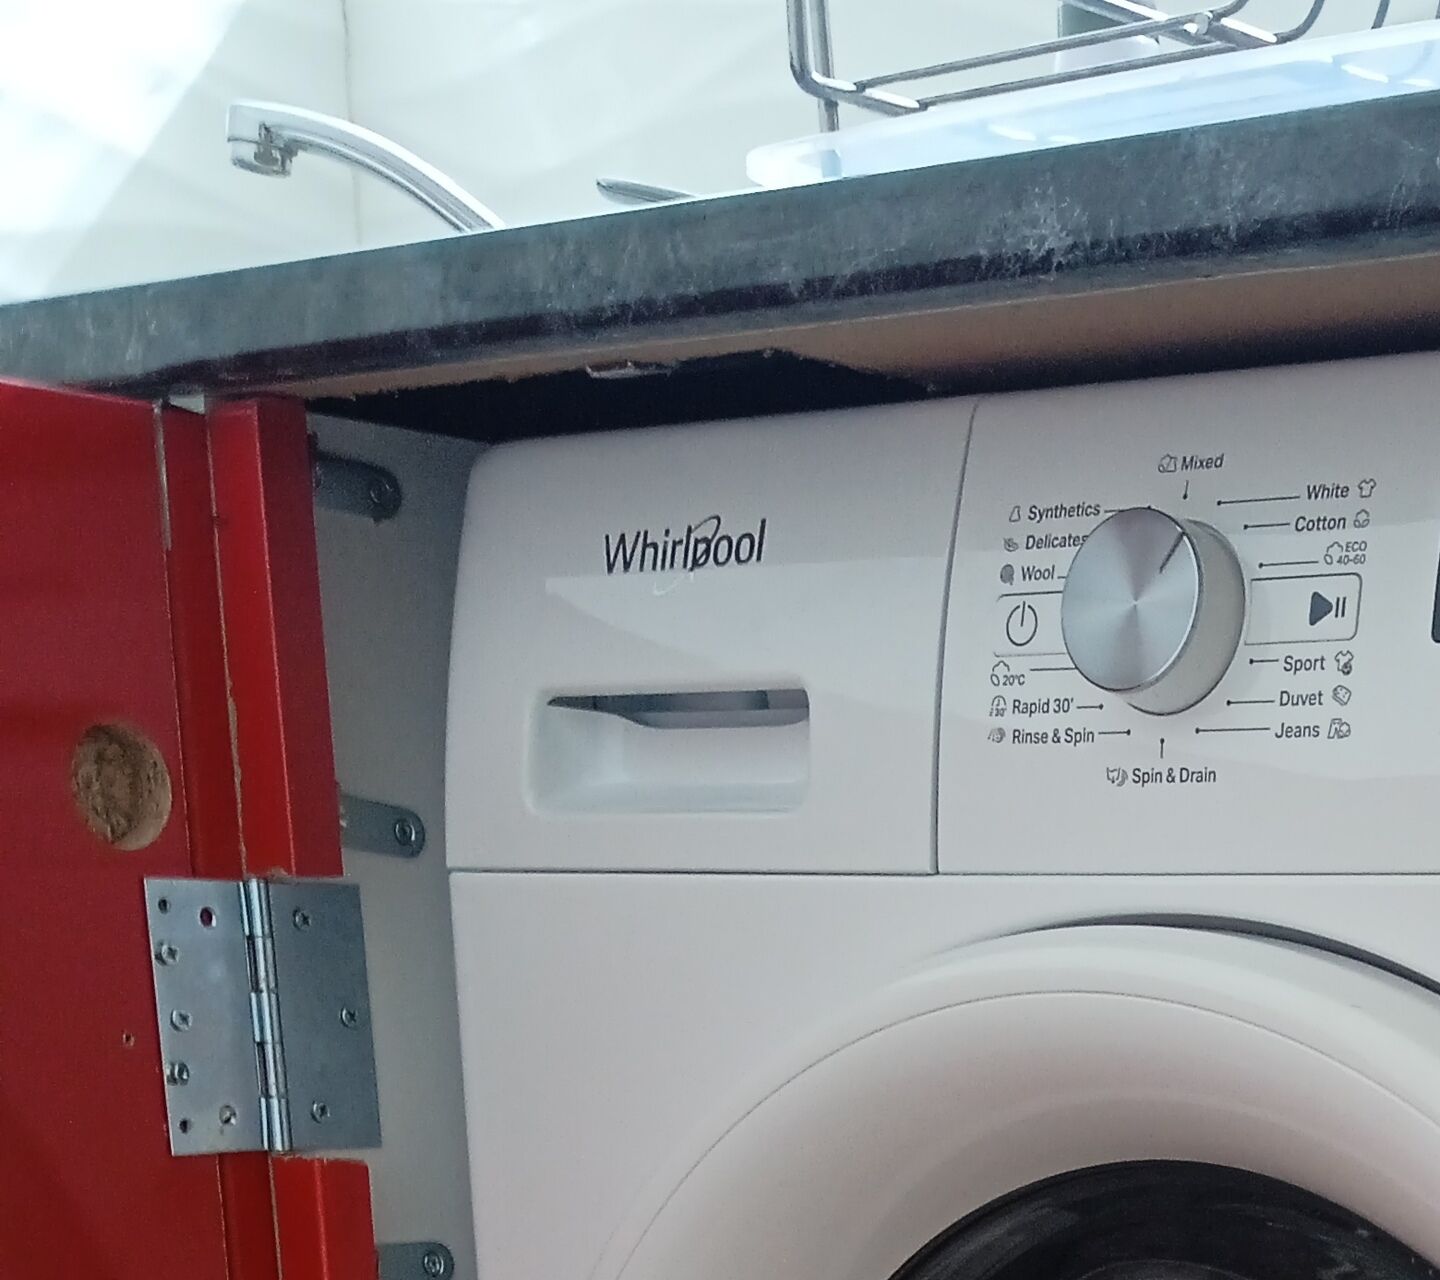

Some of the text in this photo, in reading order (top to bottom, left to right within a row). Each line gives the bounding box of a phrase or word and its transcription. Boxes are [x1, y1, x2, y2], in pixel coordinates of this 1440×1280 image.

[1181, 453, 1224, 471] Mixed
[1306, 483, 1350, 500] White
[1028, 502, 1101, 523] Synthetics
[1294, 516, 1347, 532] Cotton
[604, 514, 766, 574] Whirlpool
[1345, 541, 1368, 553] ECO
[1336, 554, 1367, 565] 40-60
[1021, 564, 1055, 581] Wool
[1283, 655, 1326, 675] Sport
[1279, 690, 1324, 706] Duvet
[1012, 698, 1050, 718] Rapid
[1012, 727, 1095, 747] Rinse & Spin
[1275, 722, 1320, 738] Jeans
[1132, 766, 1217, 788] Spin & Drain
